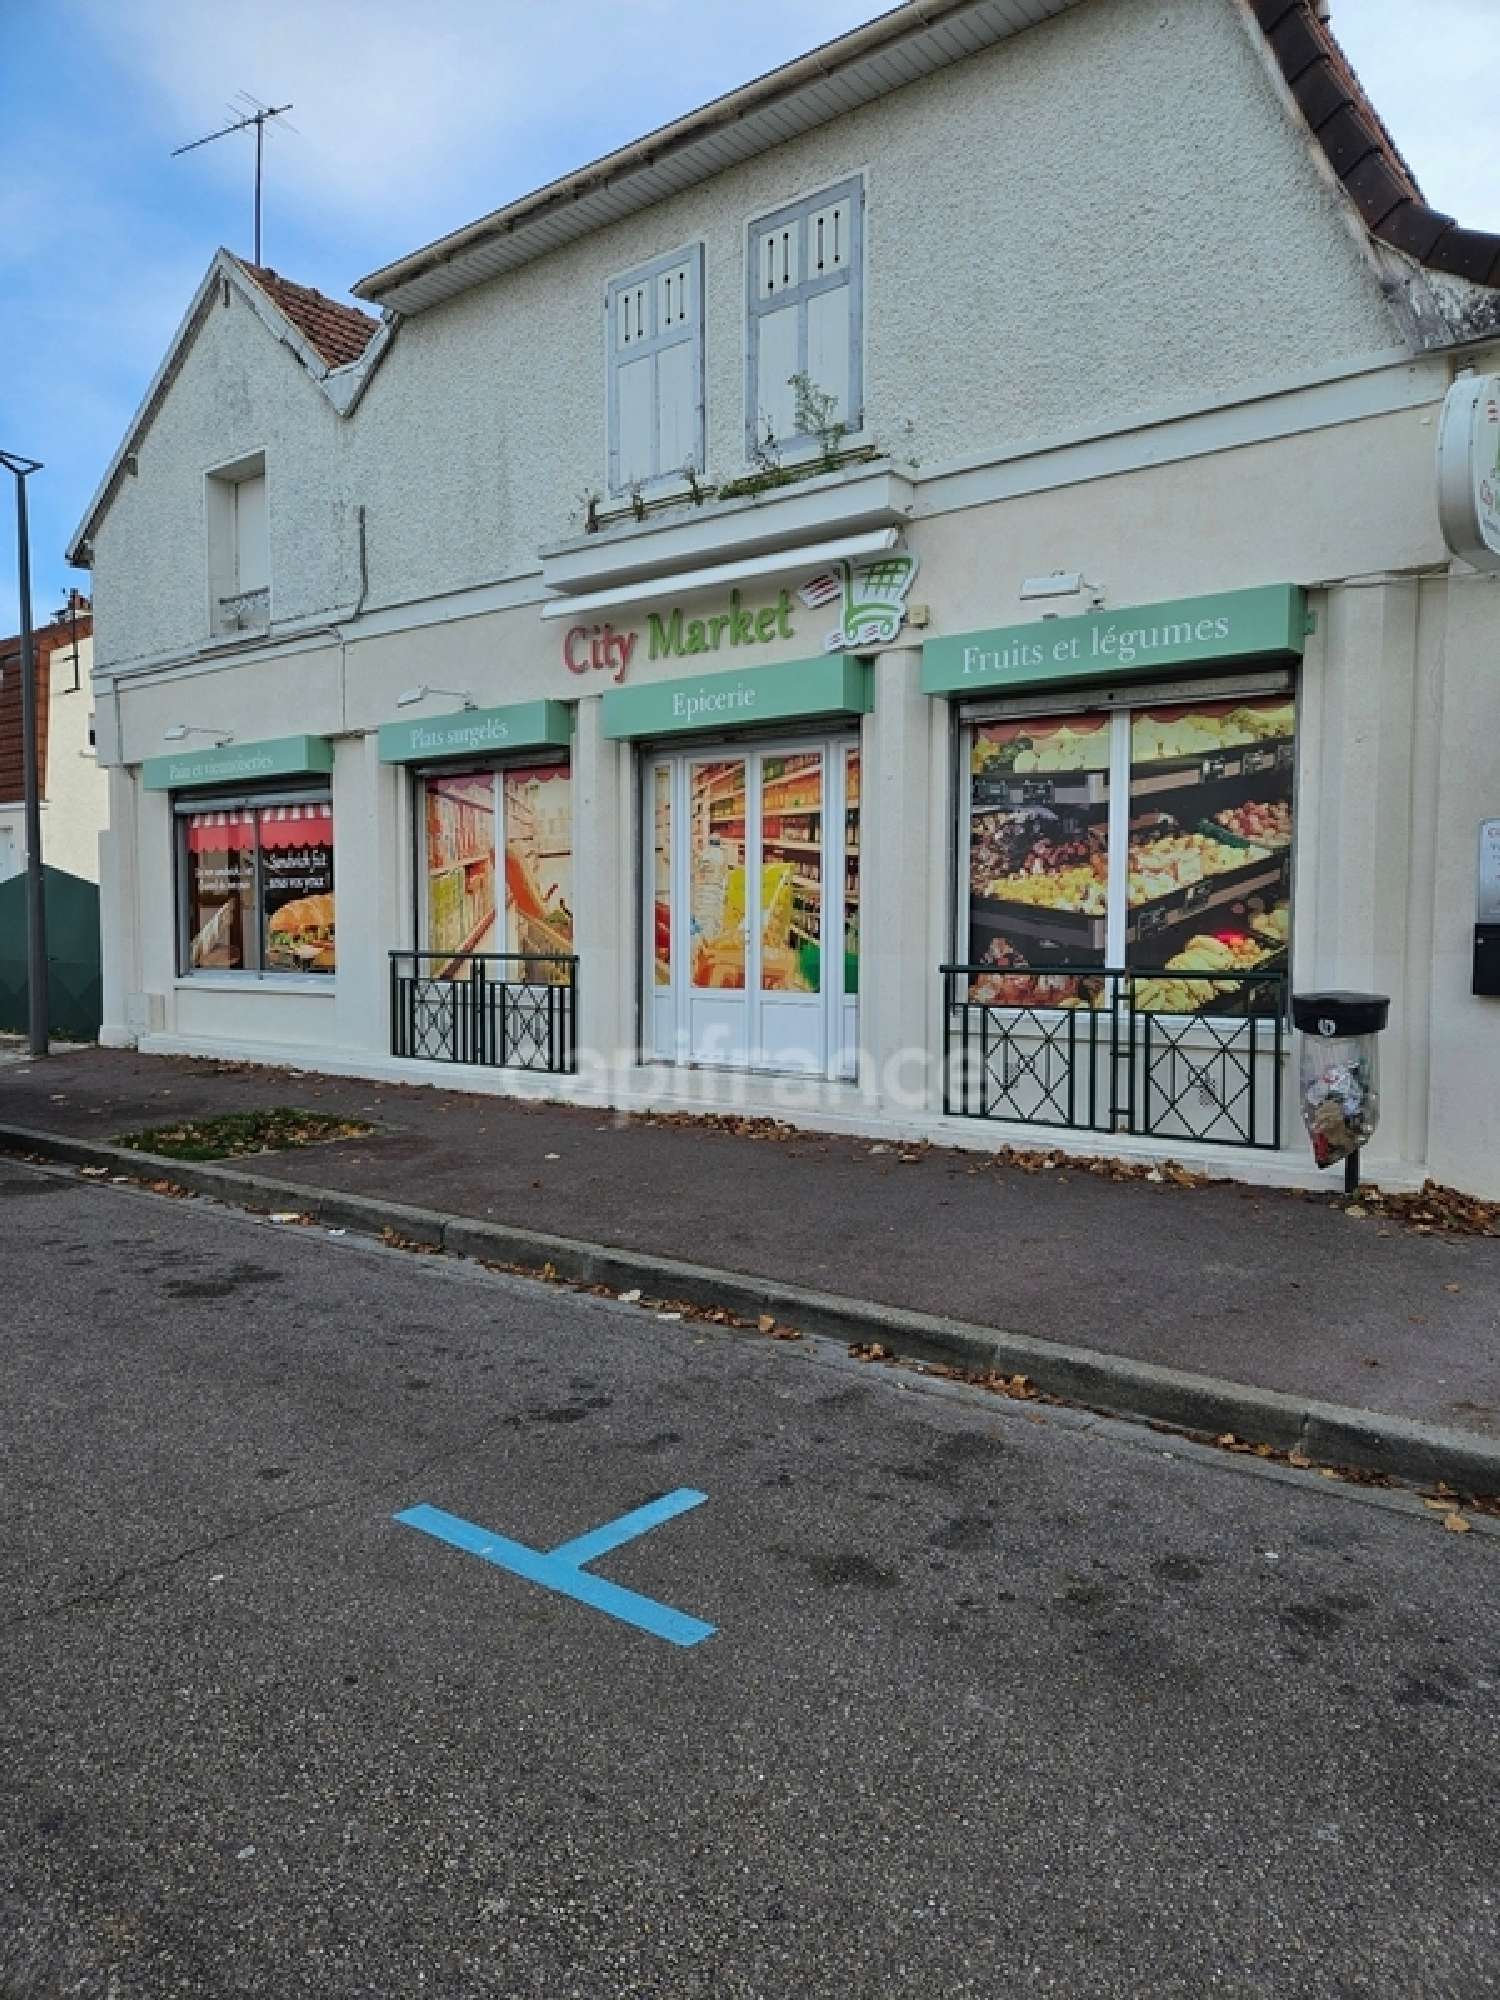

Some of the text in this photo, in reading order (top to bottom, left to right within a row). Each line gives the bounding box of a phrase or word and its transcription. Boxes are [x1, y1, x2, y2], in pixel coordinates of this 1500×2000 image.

[563, 587, 794, 684] City Market
[961, 614, 1230, 674] Fruits et légumes
[671, 682, 757, 720] Epicerie
[410, 717, 510, 750] Plats surgelés
